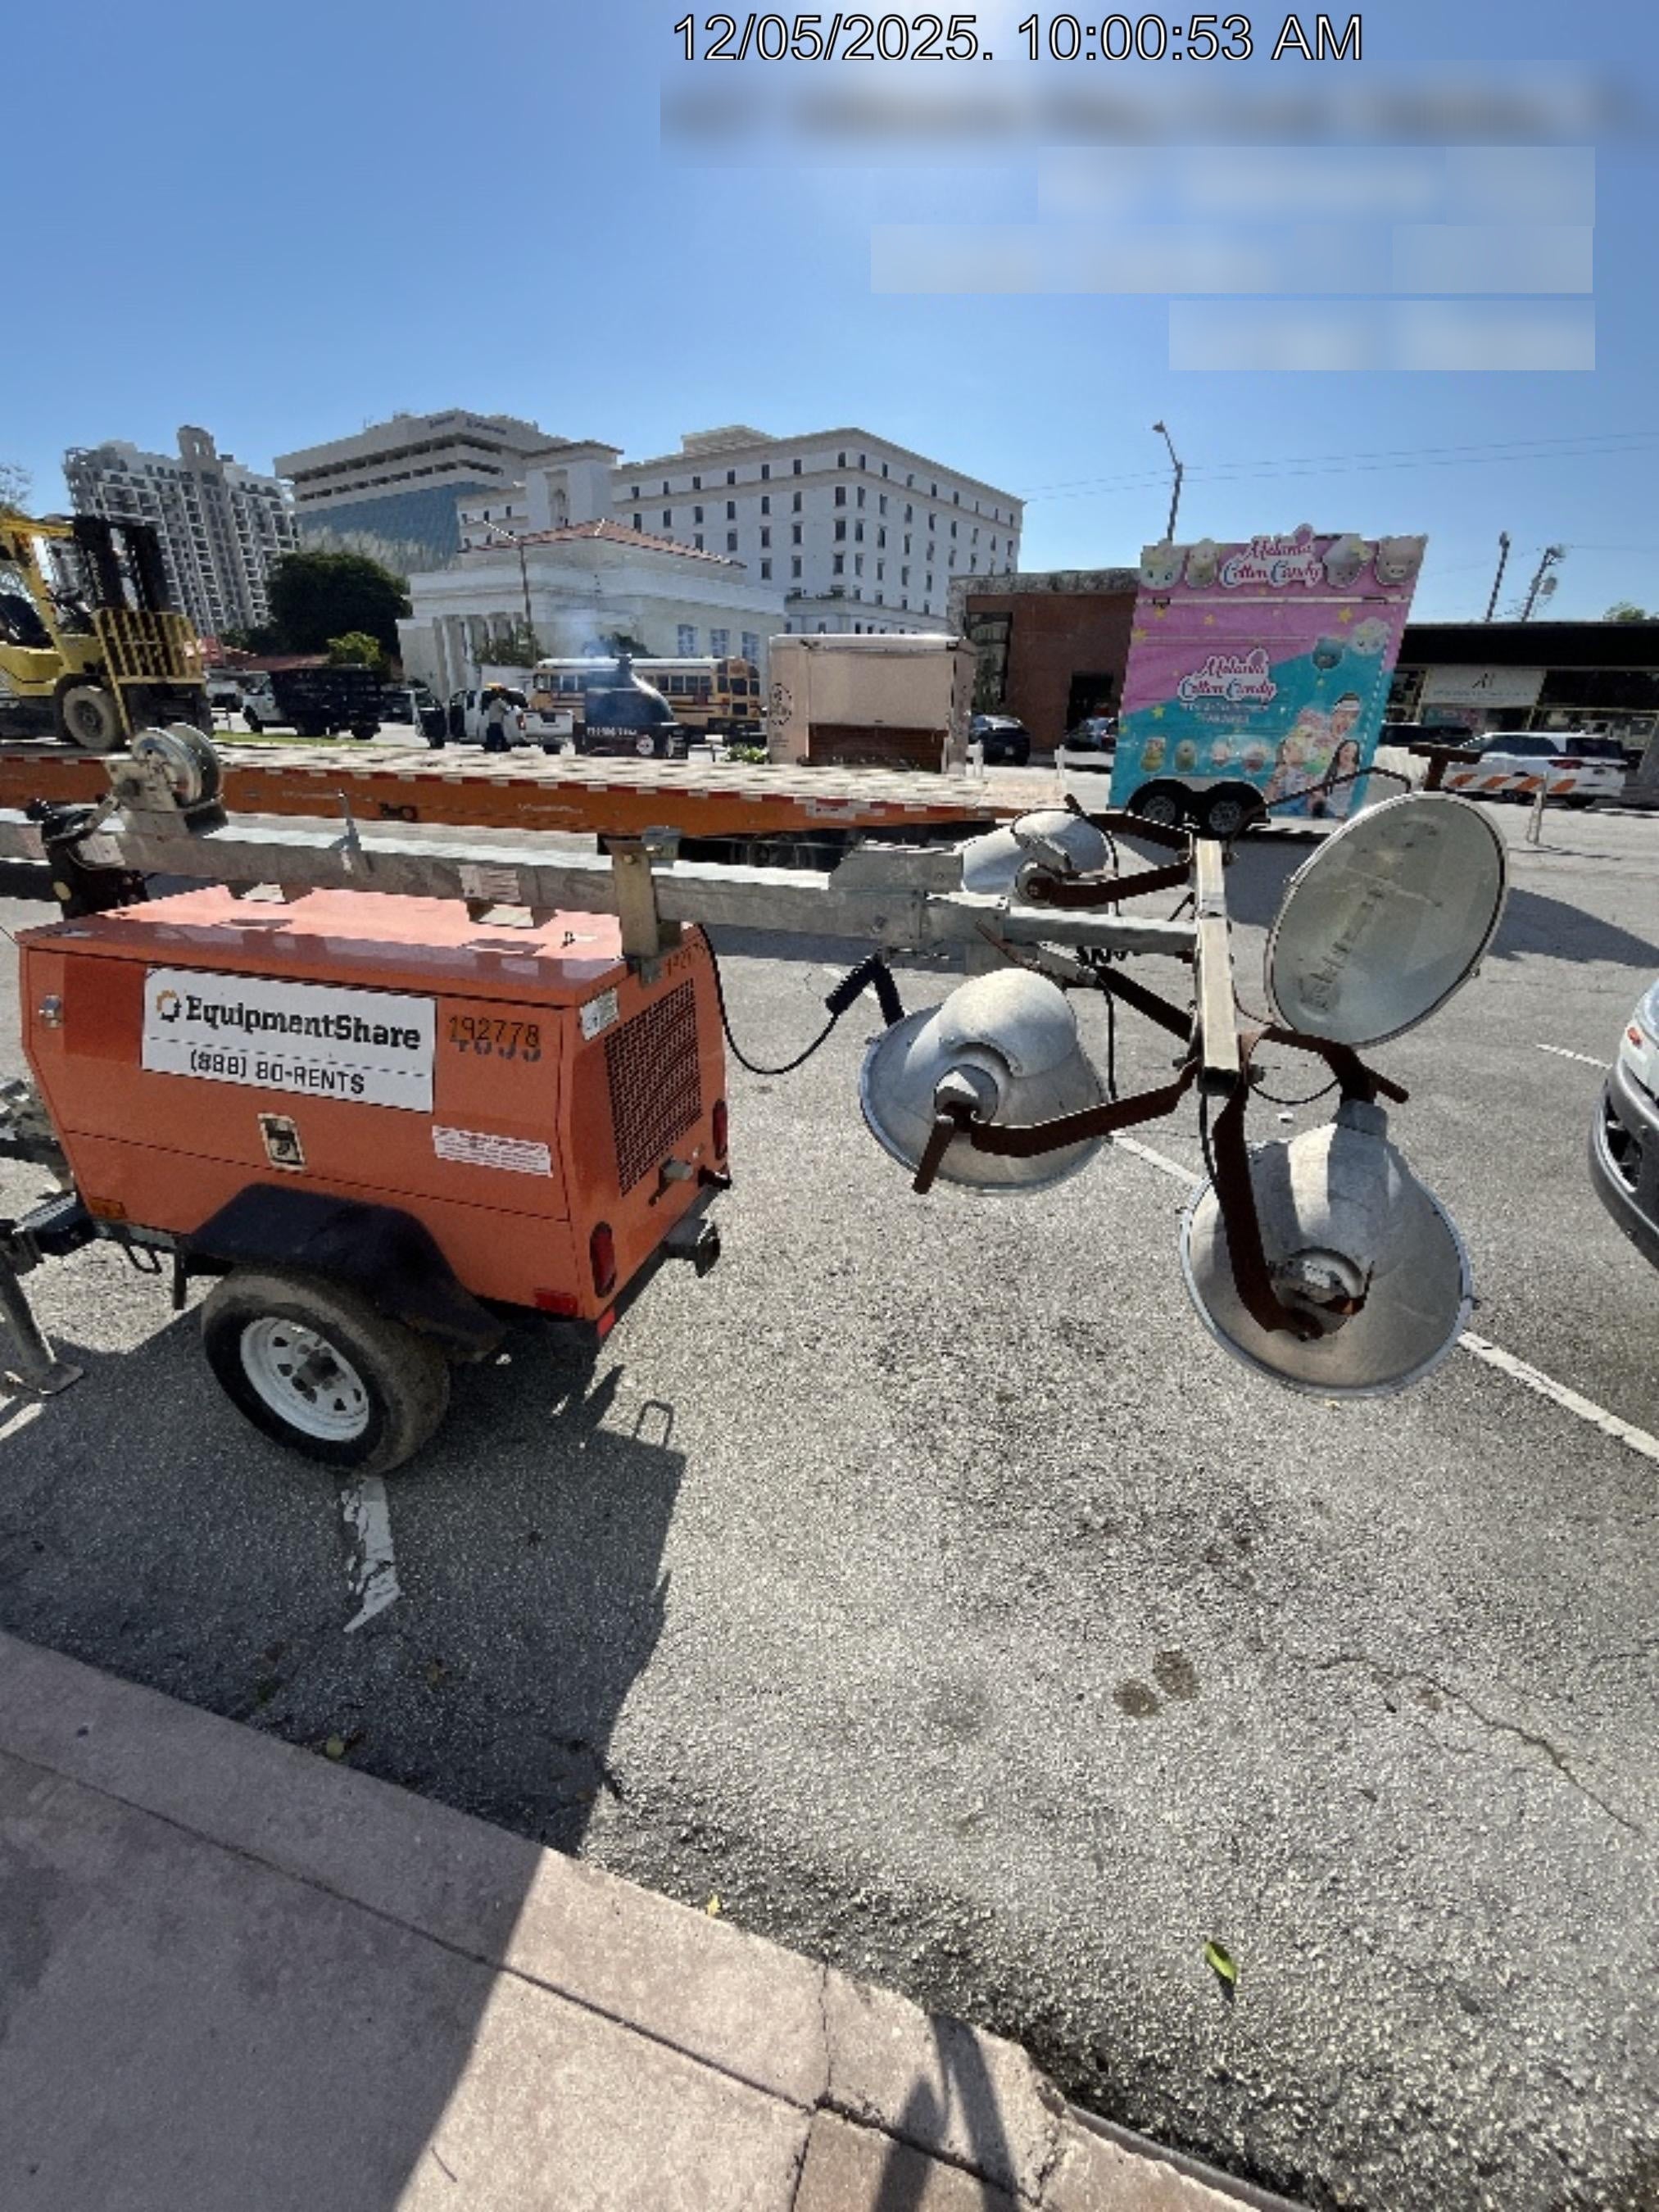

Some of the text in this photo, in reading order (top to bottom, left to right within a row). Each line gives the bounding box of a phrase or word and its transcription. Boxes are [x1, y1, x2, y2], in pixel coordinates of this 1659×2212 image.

[1271, 559, 1320, 585] Candy
[185, 995, 421, 1050] EquipmentShare
[448, 1015, 539, 1049] 192778
[190, 1049, 365, 1103] (888) 80-RENTS
